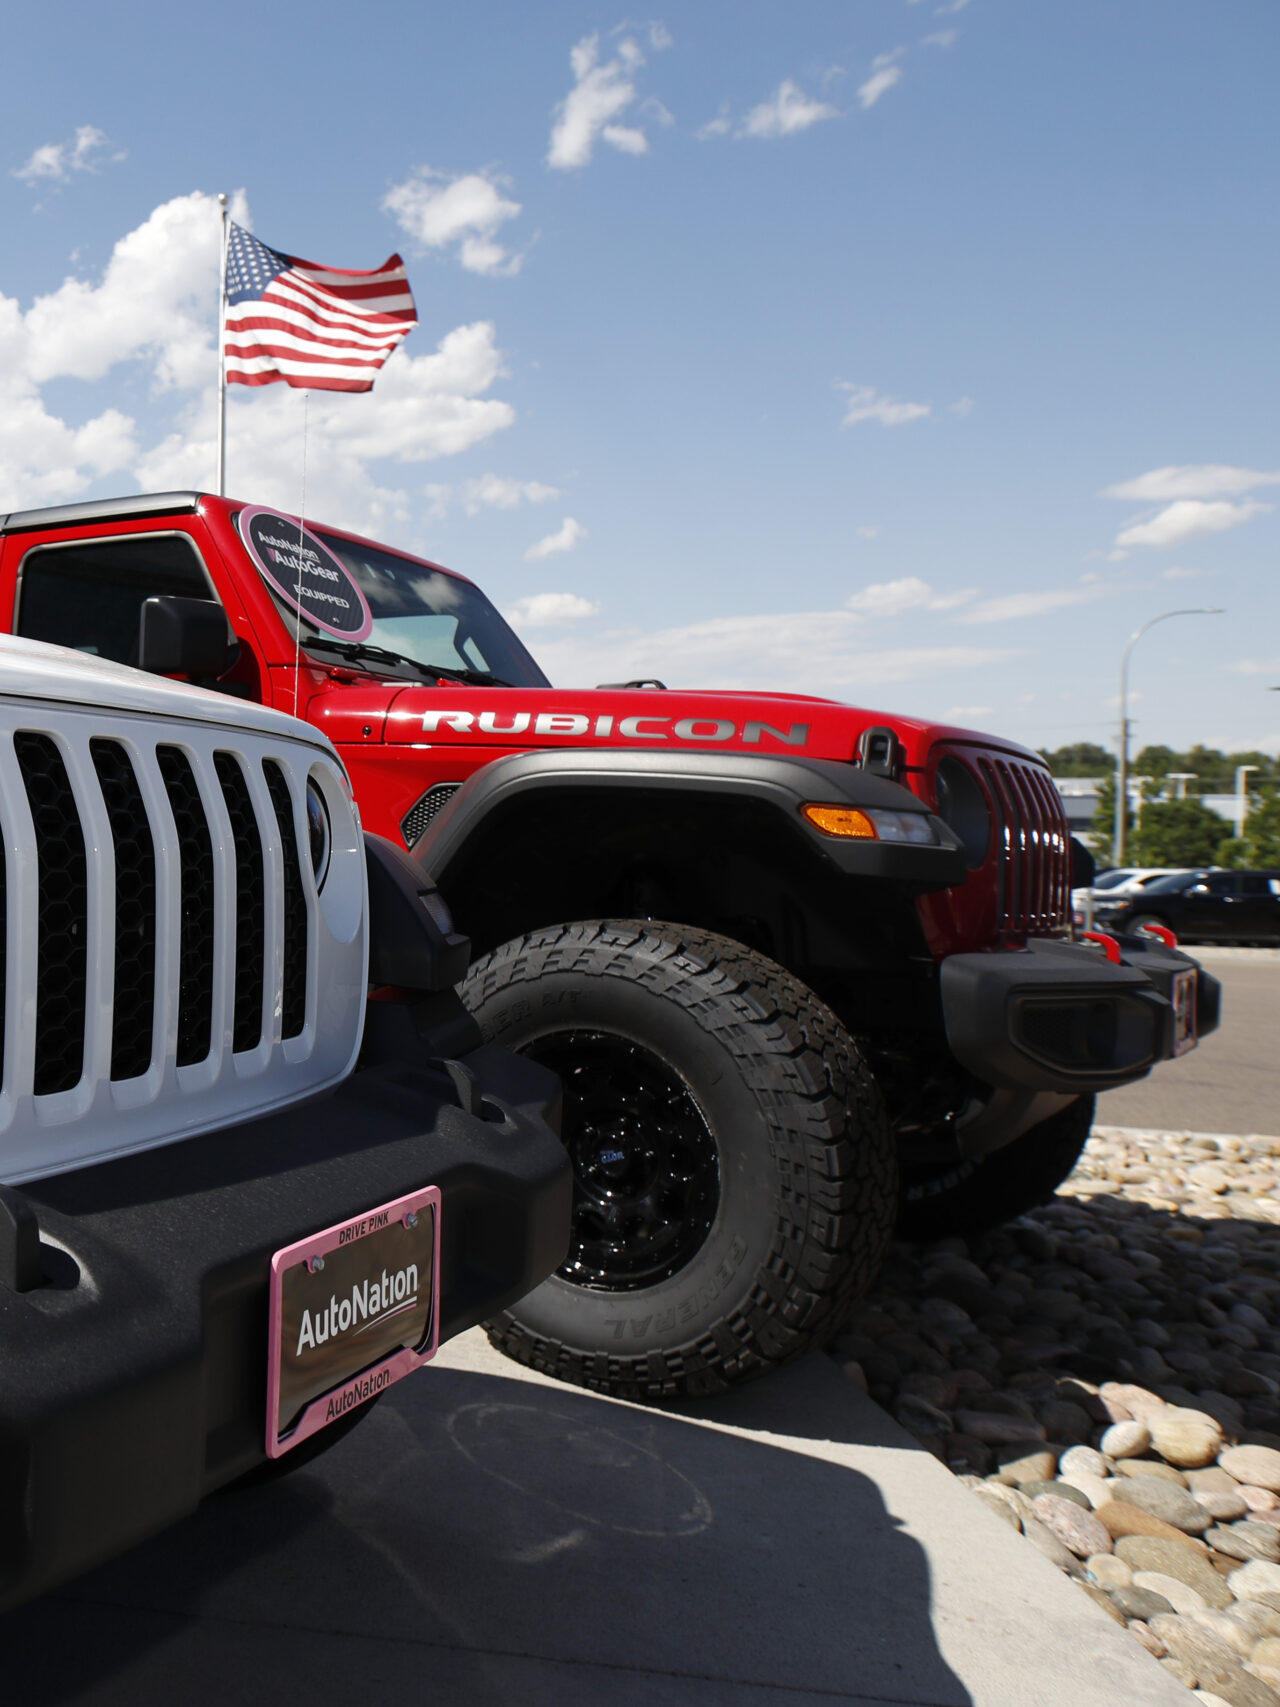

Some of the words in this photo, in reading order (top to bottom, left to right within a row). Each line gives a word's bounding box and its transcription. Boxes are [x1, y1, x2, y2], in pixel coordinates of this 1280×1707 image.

[258, 531, 320, 560] AutoNation
[273, 549, 340, 583] AutoGear
[293, 584, 350, 609] EQUIPPED
[421, 710, 812, 746] RUBICON
[338, 1220, 366, 1245] DRIVE
[369, 1211, 390, 1232] PINK
[604, 1232, 750, 1340] GENERAL
[296, 1263, 418, 1357] AutoNation
[325, 1368, 391, 1422] AutoNation
